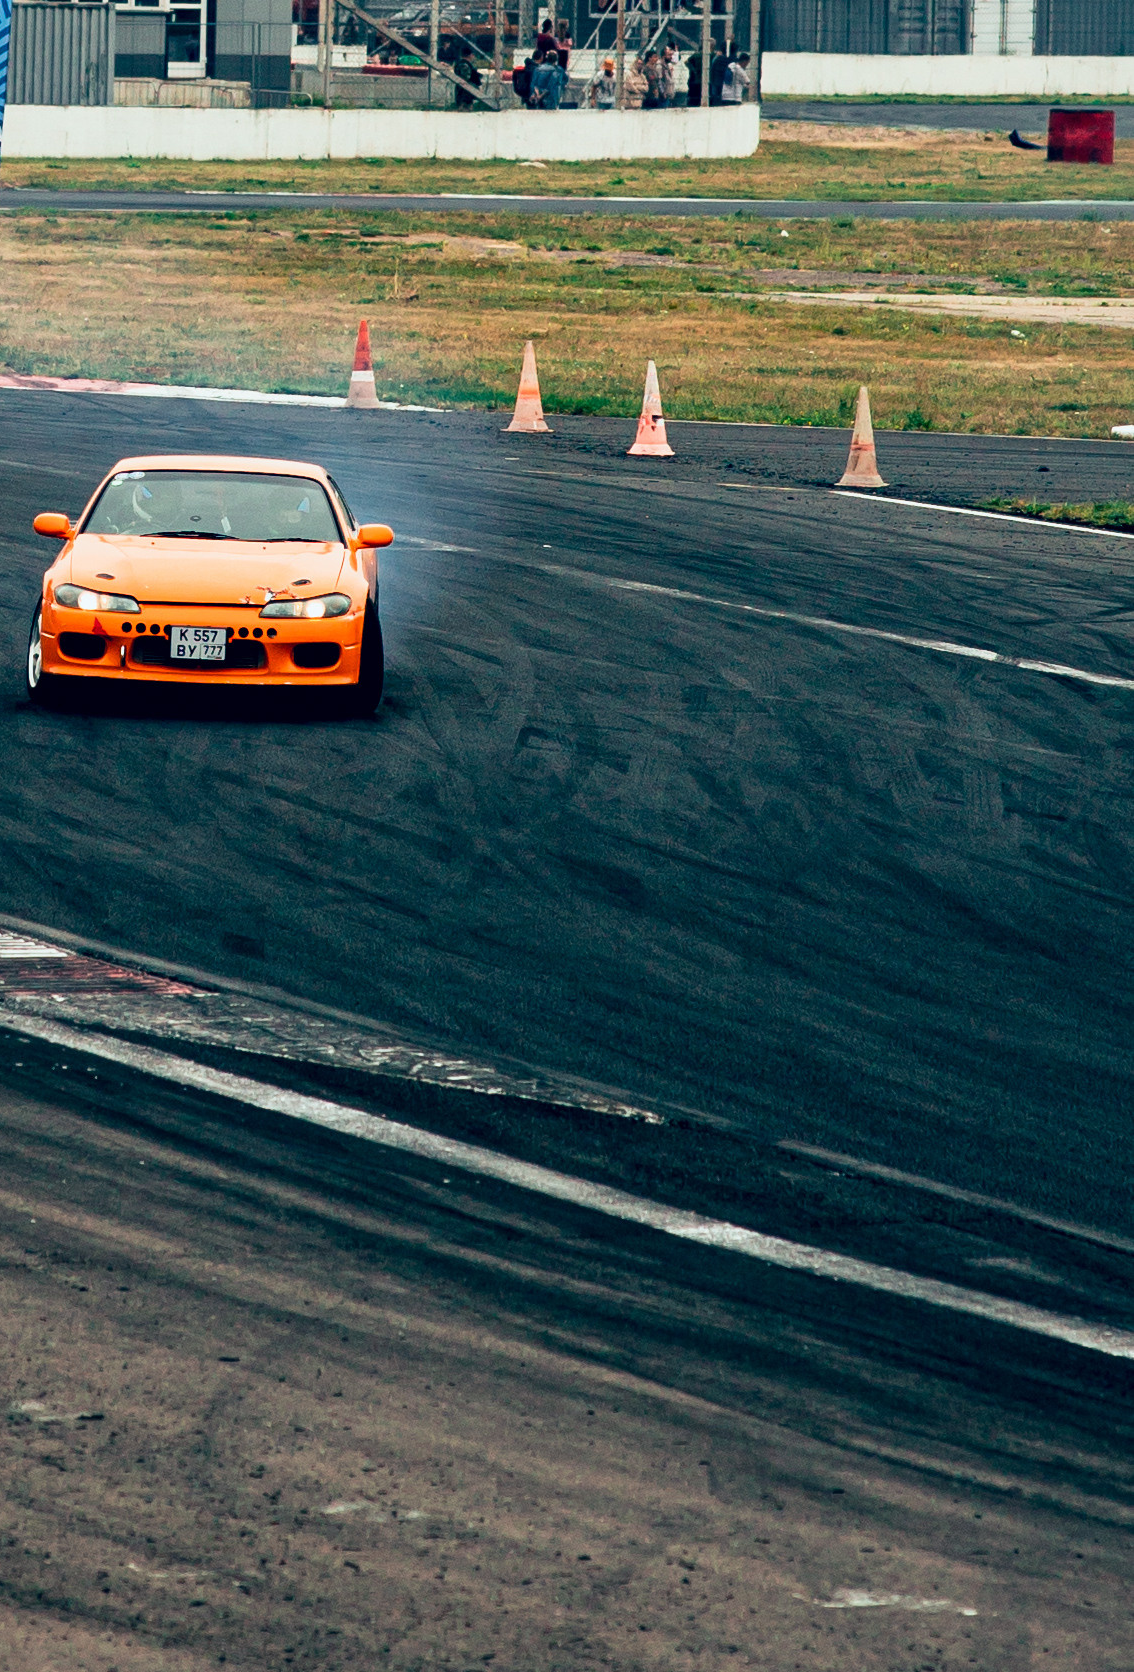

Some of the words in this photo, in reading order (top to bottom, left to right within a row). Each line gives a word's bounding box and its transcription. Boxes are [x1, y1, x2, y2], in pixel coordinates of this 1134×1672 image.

[180, 629, 188, 641] K
[193, 630, 218, 642] 557
[203, 645, 222, 655] 777
